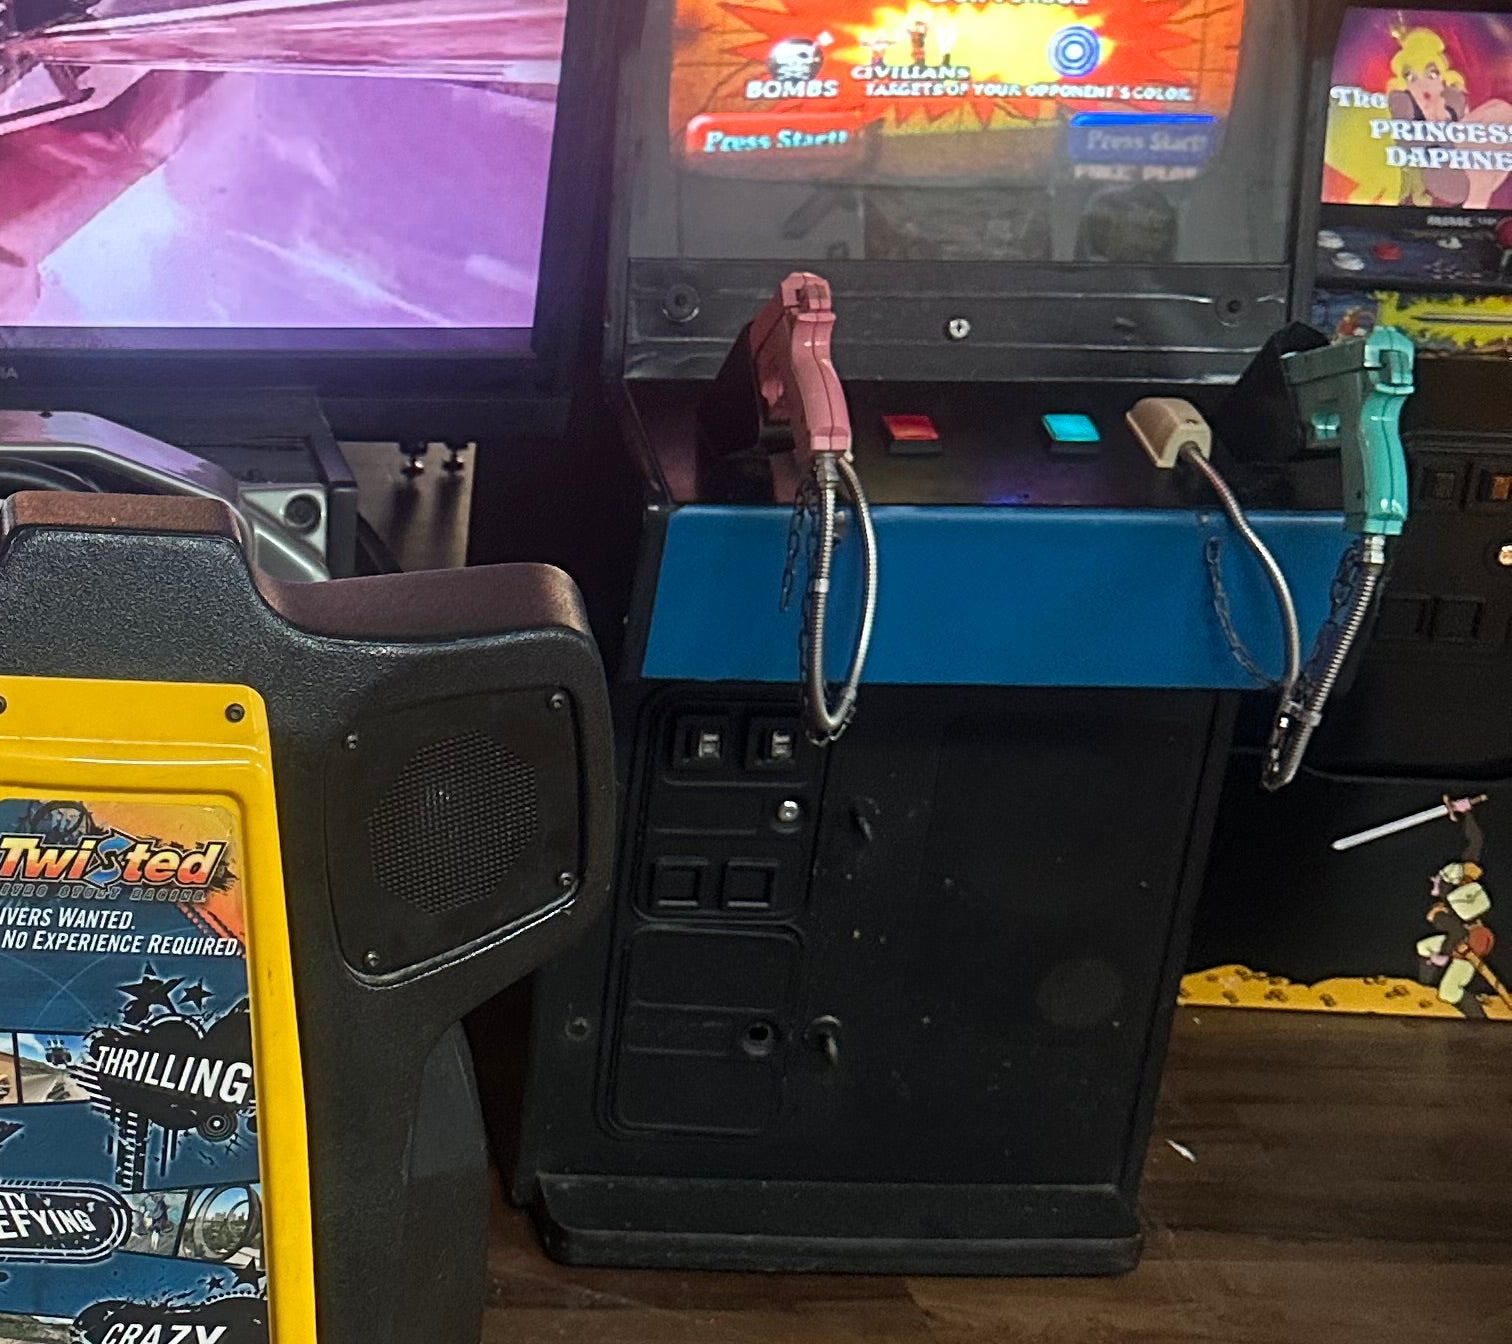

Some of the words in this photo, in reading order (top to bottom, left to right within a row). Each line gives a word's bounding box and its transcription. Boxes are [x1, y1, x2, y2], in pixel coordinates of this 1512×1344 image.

[850, 65, 971, 80] CIVILIANS
[746, 80, 839, 99] BOMBS
[865, 82, 942, 97] TARGETS
[944, 82, 968, 97] OF
[972, 83, 1021, 97] YOUR
[704, 131, 771, 153] Press
[1086, 130, 1145, 151] Press
[1370, 119, 1512, 144] PRINCES
[1385, 146, 1512, 172] DAPHNE
[58, 905, 137, 931] WANTED.
[1, 930, 29, 950] NO
[32, 931, 144, 954] EXPERIENCE
[147, 934, 243, 957] REQUIRED.
[97, 1044, 253, 1105] THRILLING
